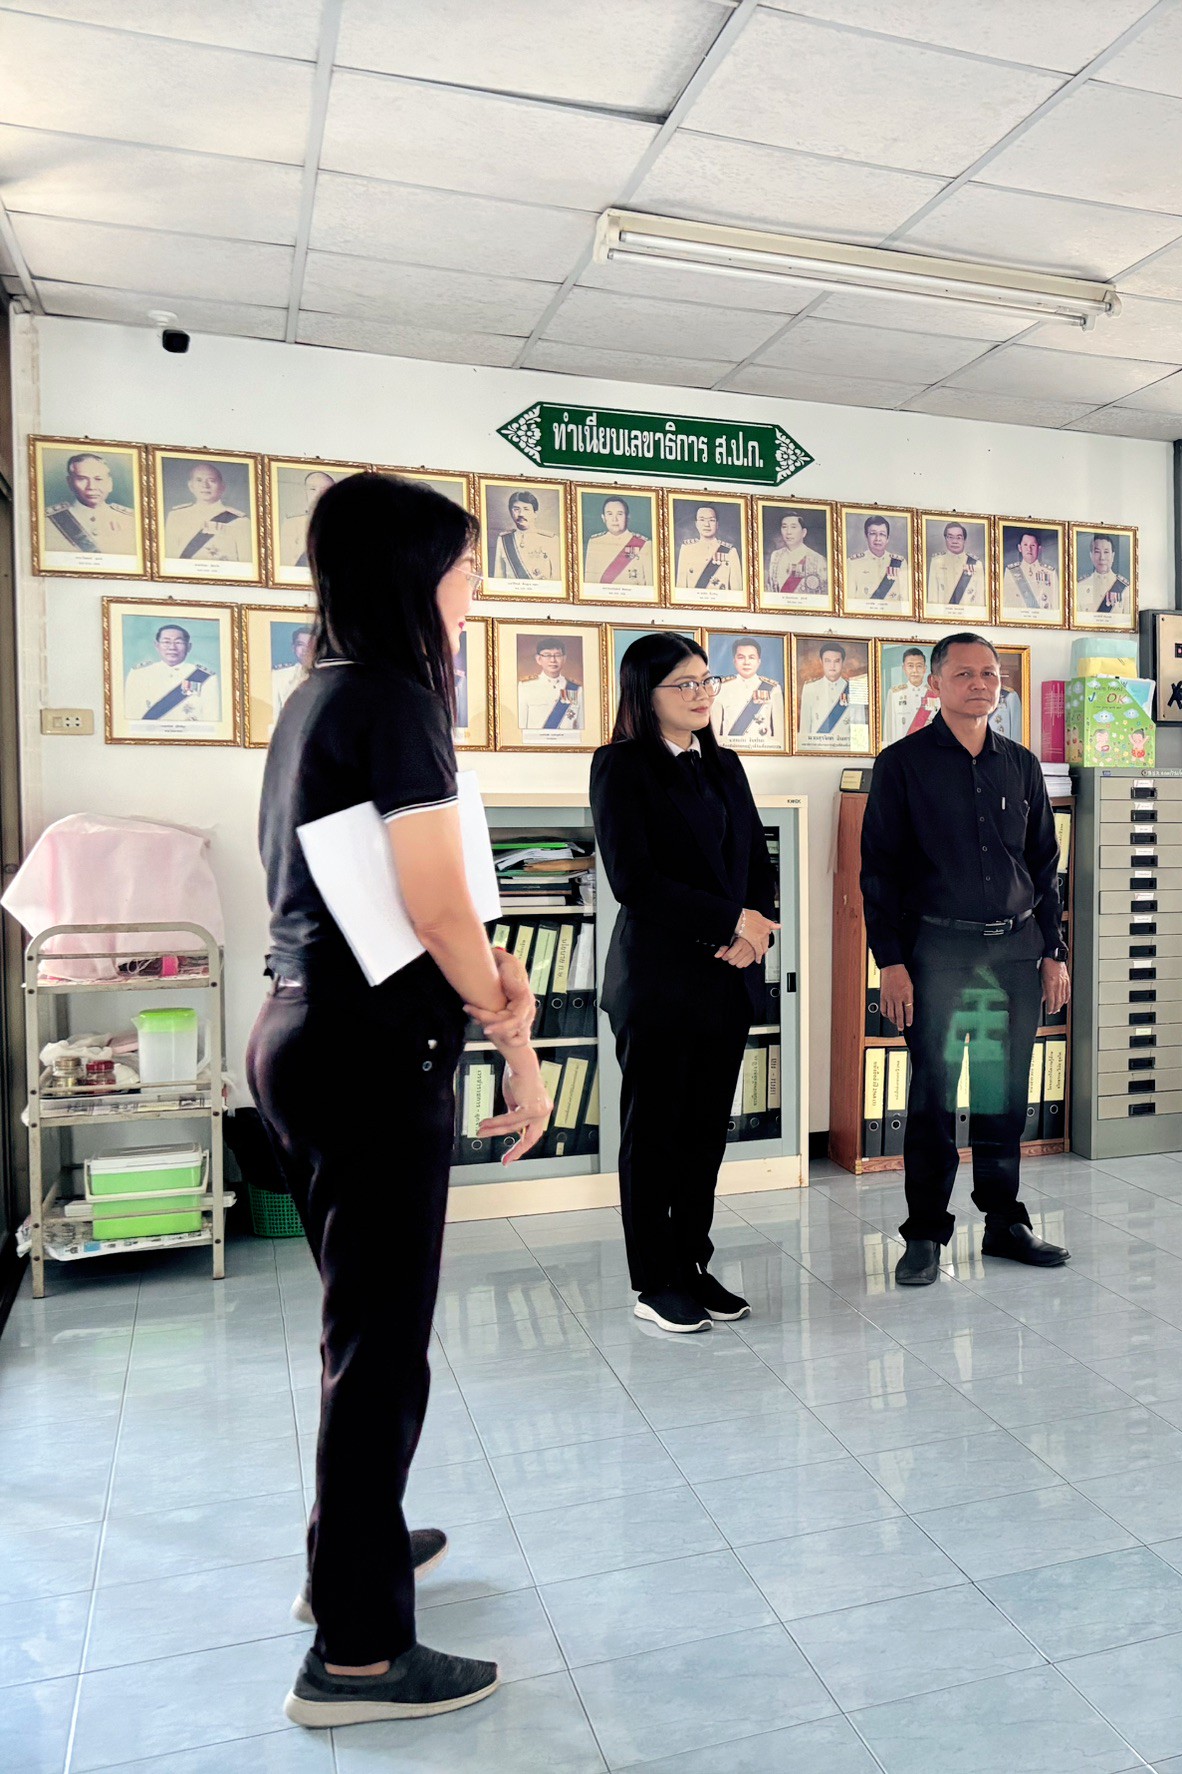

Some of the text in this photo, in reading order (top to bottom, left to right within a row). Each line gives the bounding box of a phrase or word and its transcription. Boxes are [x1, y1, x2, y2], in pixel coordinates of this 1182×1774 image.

[552, 411, 764, 468] ทำเนียบเลขาธิการ ส.ป.ก.
